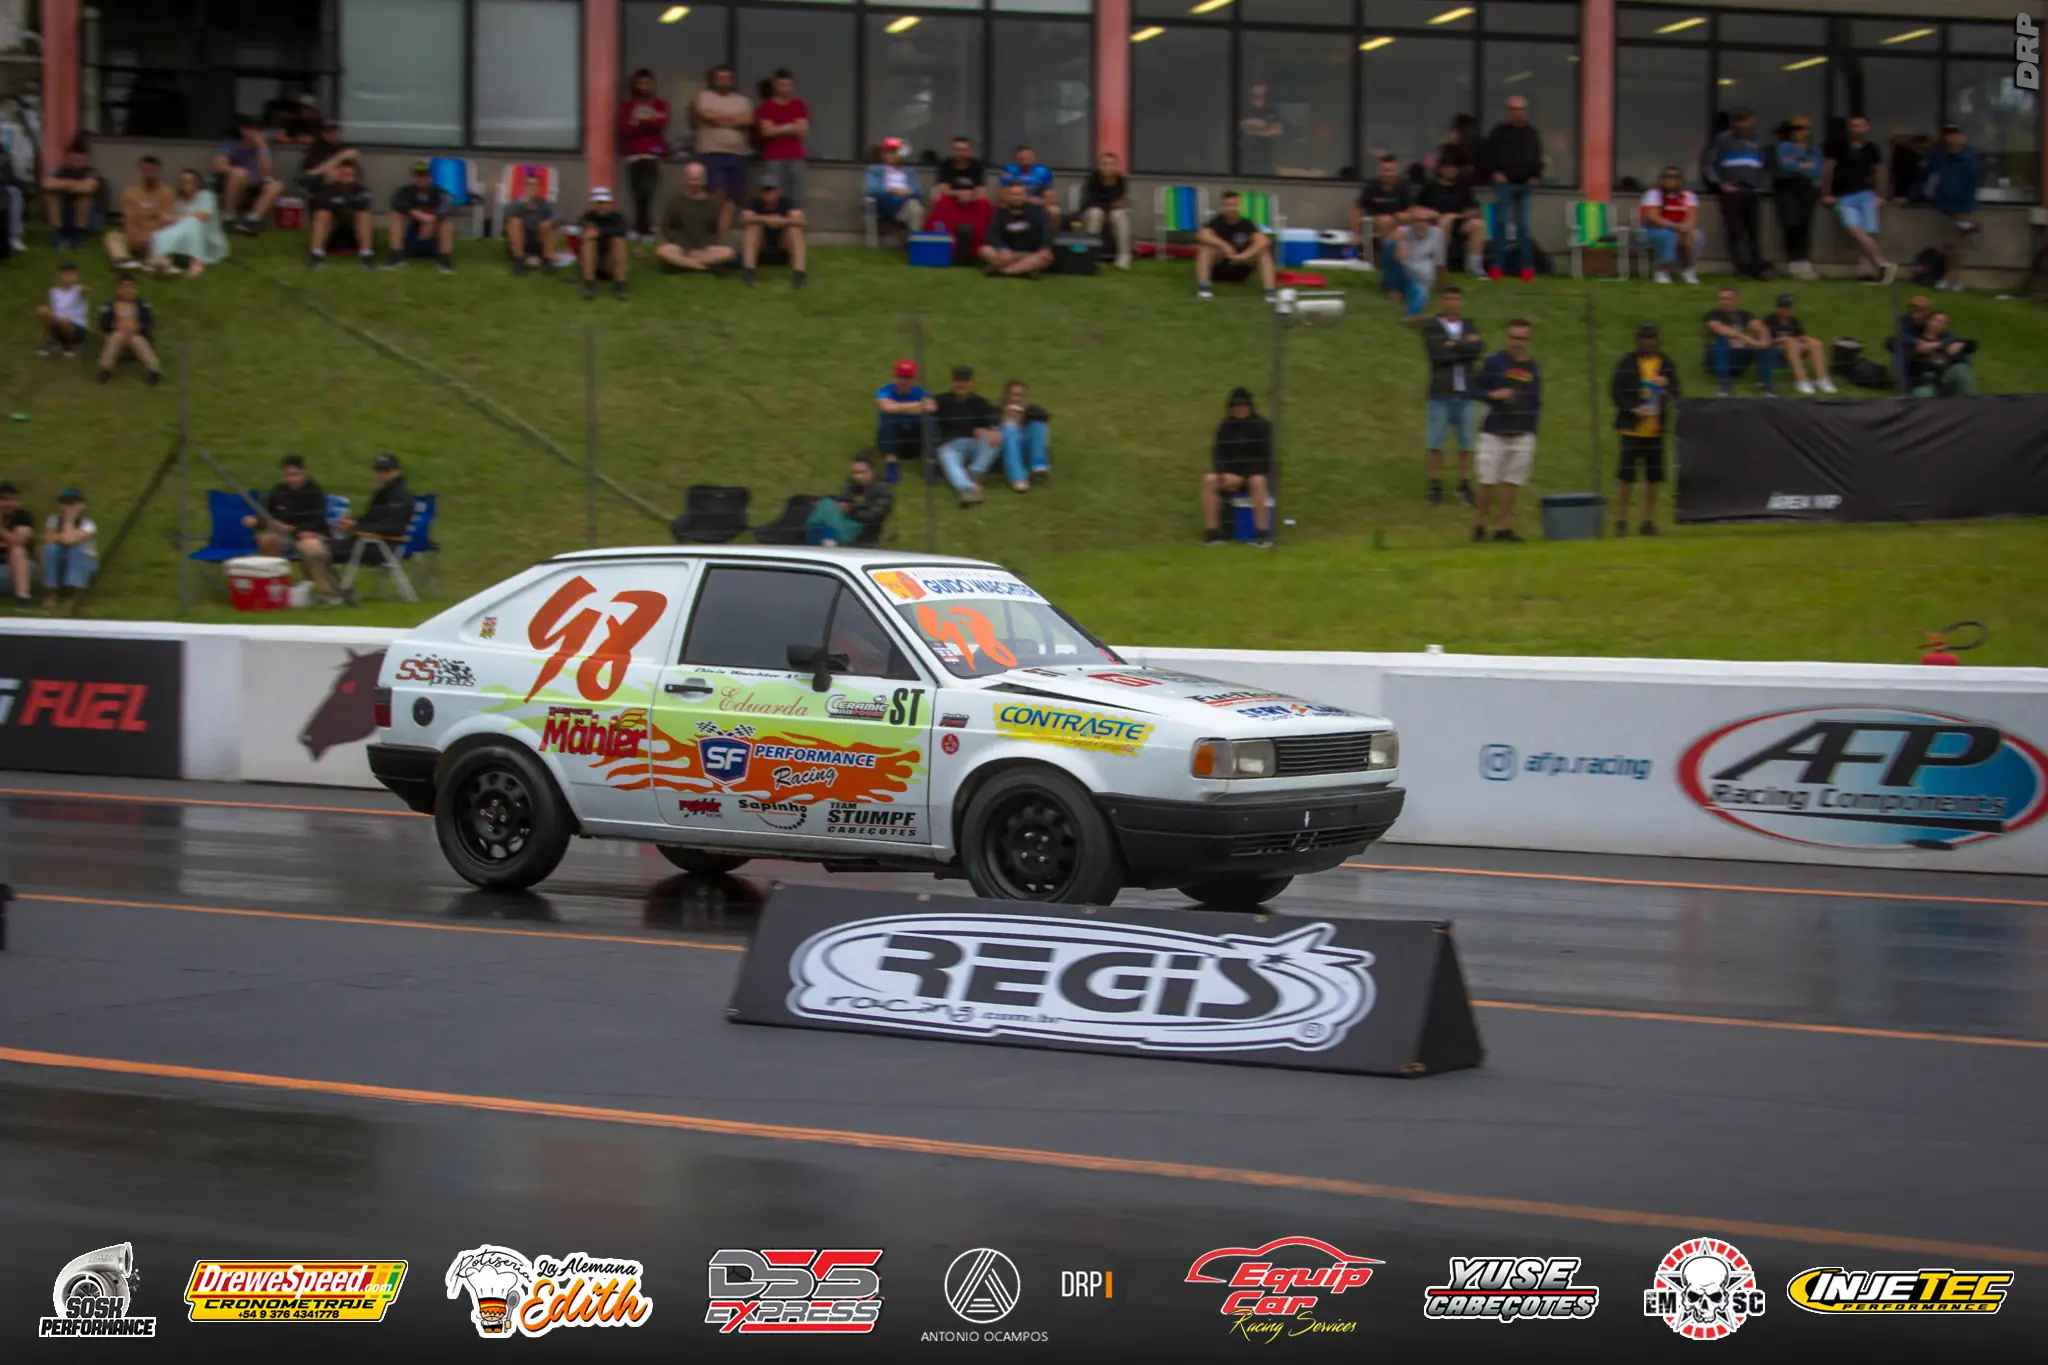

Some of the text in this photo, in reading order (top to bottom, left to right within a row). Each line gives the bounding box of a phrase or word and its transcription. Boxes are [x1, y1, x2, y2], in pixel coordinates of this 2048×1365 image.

[922, 579, 974, 595] GUIDO
[395, 658, 440, 681] SS
[19, 679, 148, 731] FUEL
[718, 686, 809, 717] Eduarda
[889, 688, 925, 726] ST
[1000, 706, 1145, 740] CONTRASTE
[707, 746, 746, 770] SF
[754, 744, 876, 768] PERFORMANCE
[1523, 749, 1652, 780] afp.racing
[1711, 718, 2004, 787] AFP
[773, 766, 839, 790] Racing
[739, 799, 808, 813] Sapinho
[1711, 782, 2008, 817] Racing Components
[827, 810, 916, 826] STUMPF
